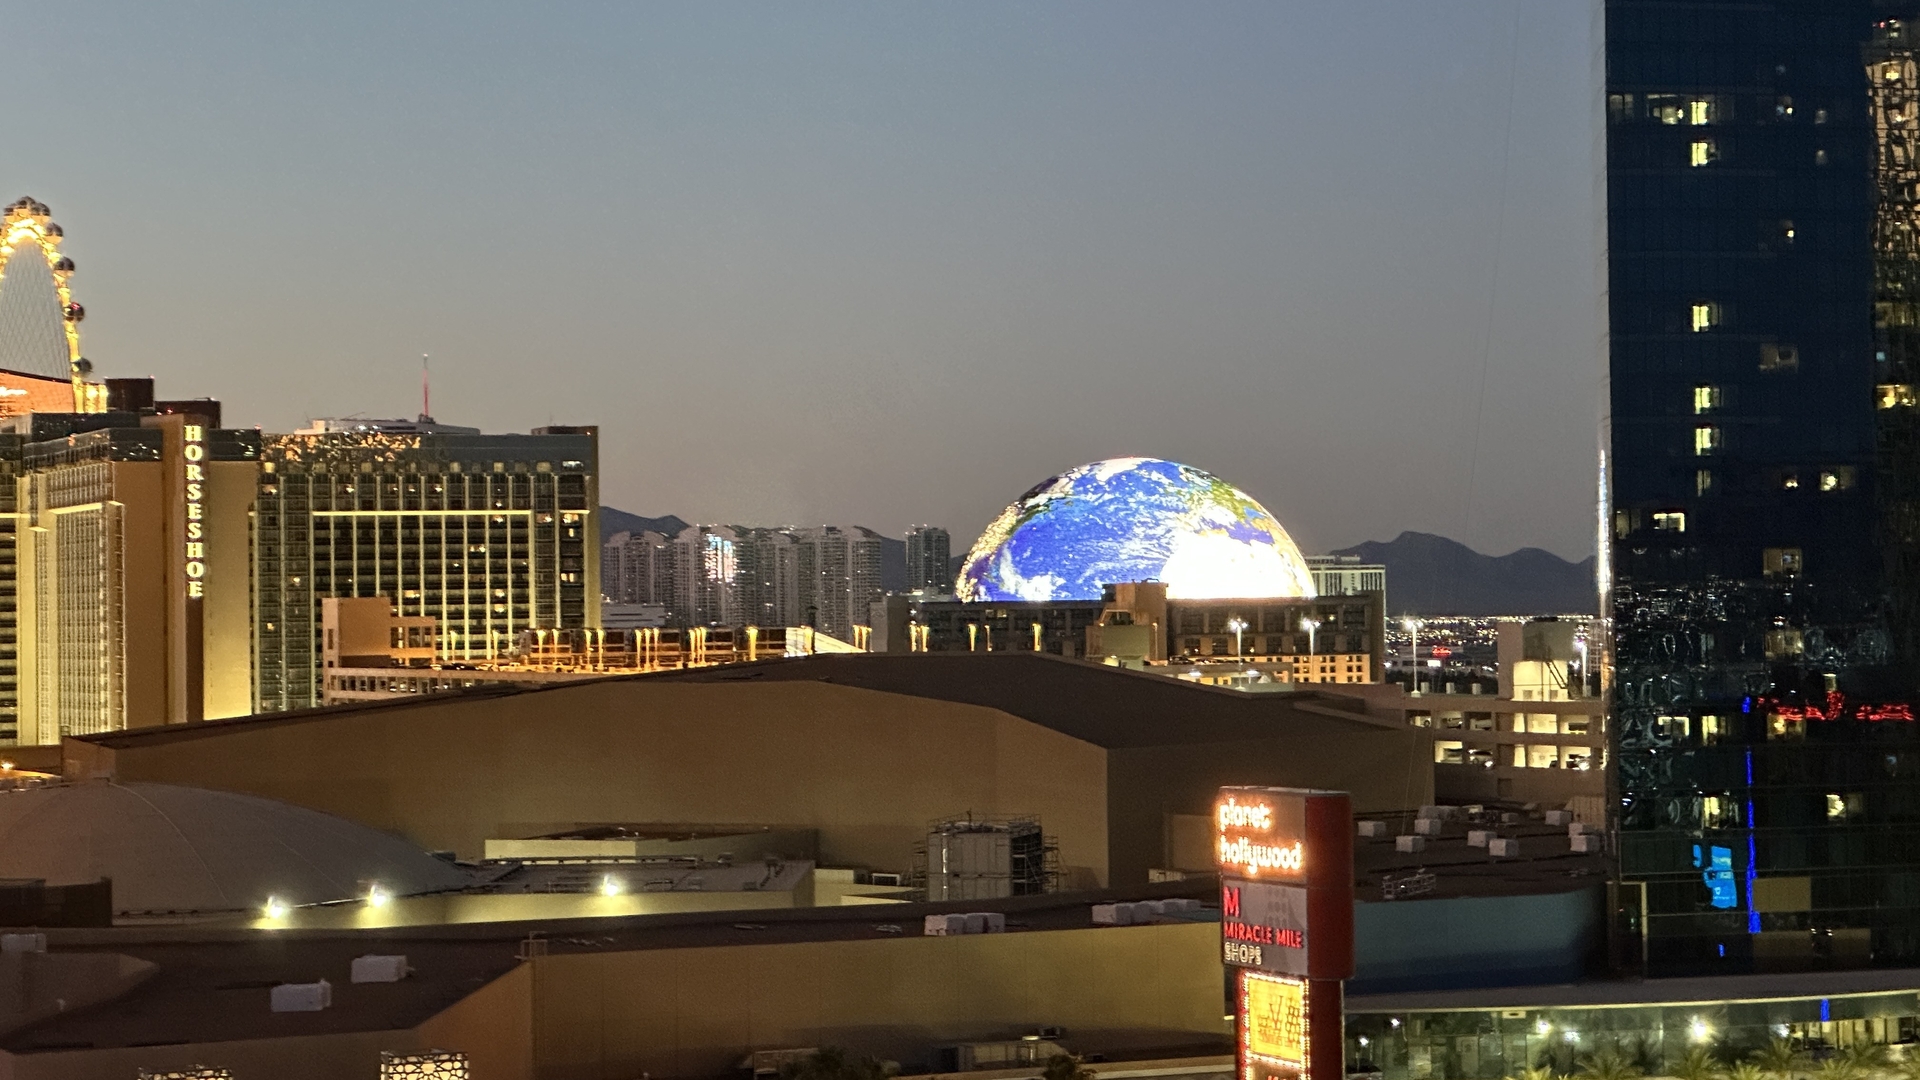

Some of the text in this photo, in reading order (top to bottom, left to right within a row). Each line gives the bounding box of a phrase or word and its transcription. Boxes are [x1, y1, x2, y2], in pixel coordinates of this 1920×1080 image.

[184, 425, 204, 598] HORSESHOE
[1220, 797, 1271, 832] planet
[1220, 834, 1302, 875] hollywood
[1223, 886, 1240, 918] M
[1224, 921, 1303, 949] MIRACLE MILE
[1224, 941, 1262, 965] SHOPS
